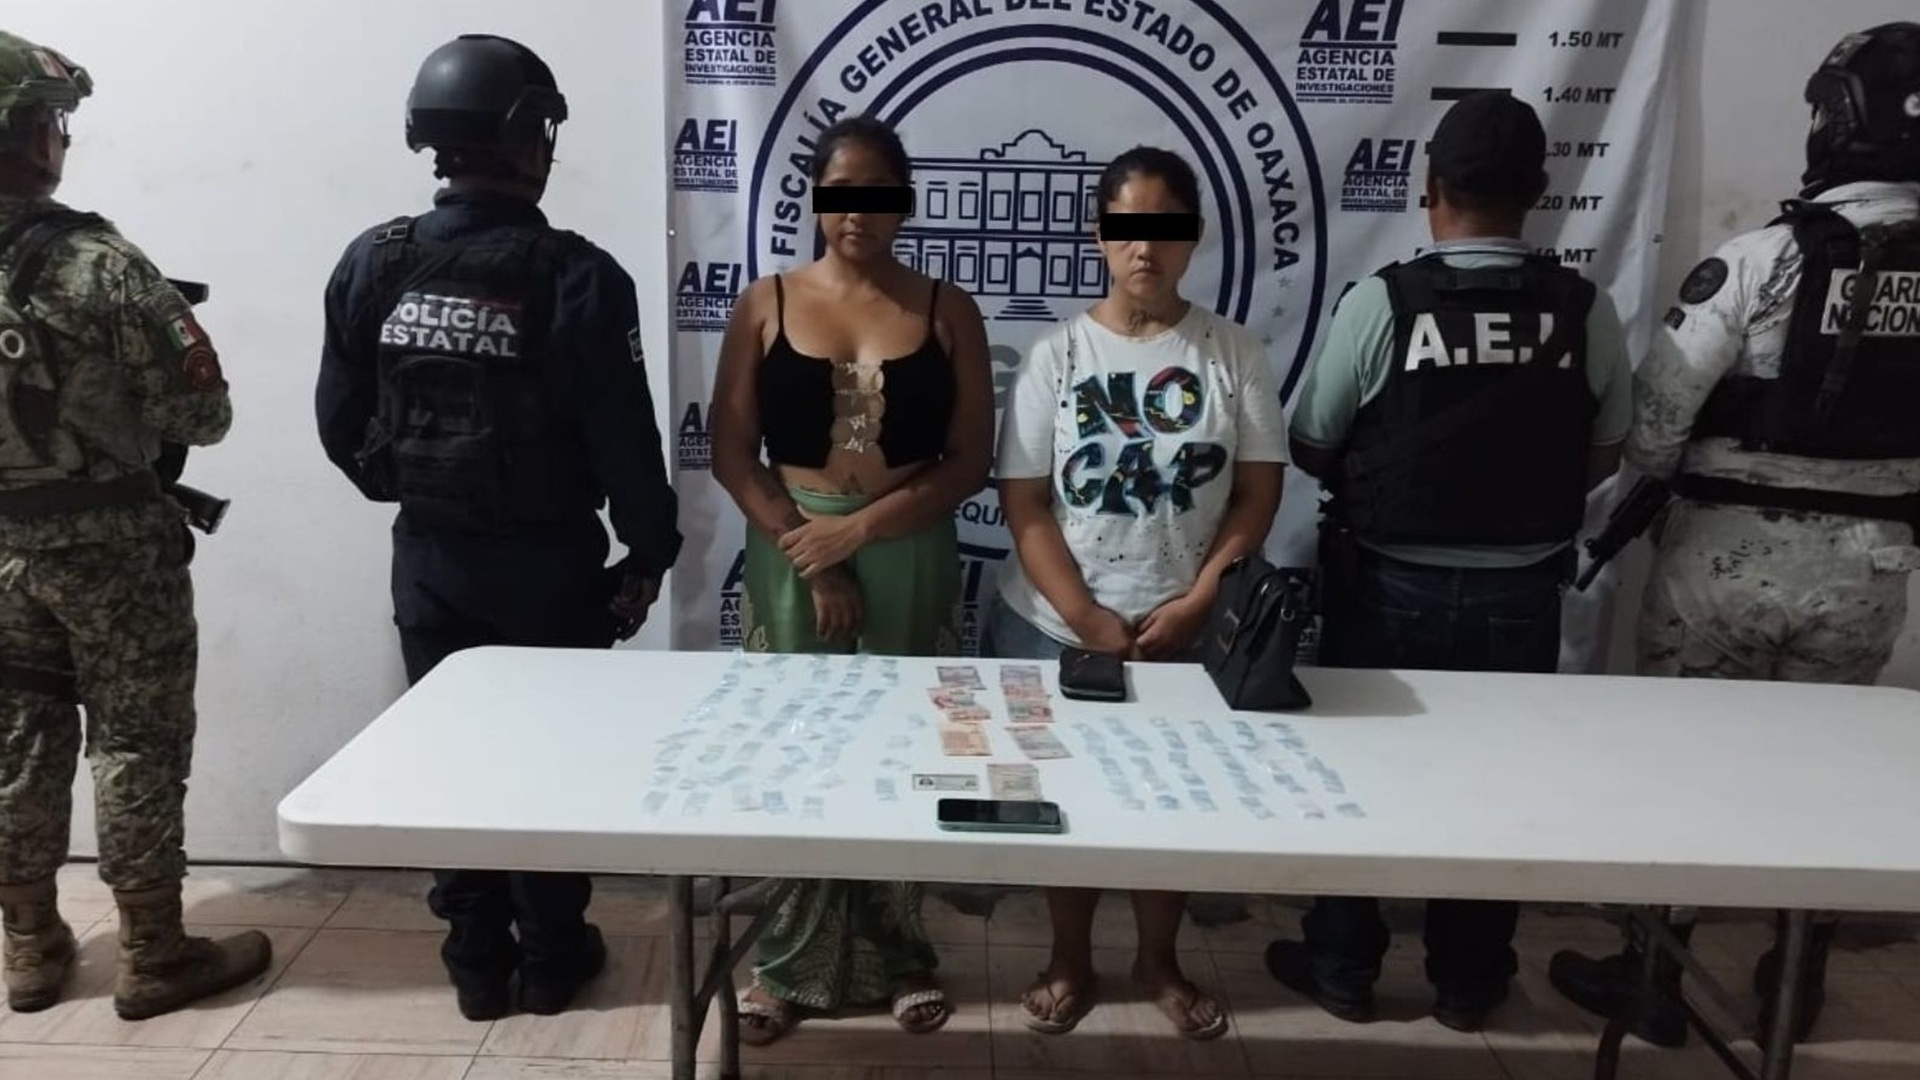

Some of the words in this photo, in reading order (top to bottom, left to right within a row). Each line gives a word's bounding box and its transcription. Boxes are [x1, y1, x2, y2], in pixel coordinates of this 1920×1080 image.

[1301, 0, 1405, 41] AEI
[685, 30, 775, 48] AGENCIA
[1548, 31, 1593, 48] 1.50
[1596, 32, 1624, 49] MT
[685, 48, 749, 62] ESTATAL
[755, 50, 776, 64] DE
[1297, 49, 1395, 66] AGENCIA
[685, 63, 776, 74] INVESTIGACIONES
[1297, 66, 1368, 81] ESTATAL
[1373, 68, 1396, 82] DE
[1295, 82, 1394, 93] INVESTIGACIONES
[1543, 86, 1581, 103] 1.40
[1585, 87, 1616, 104] MT
[674, 118, 737, 150] AEI
[840, 0, 993, 93] GENERAL
[1084, 0, 1216, 72] ESTADO
[1212, 68, 1258, 121] DE
[1247, 122, 1300, 271] OAXACA
[1345, 138, 1417, 170] AEI
[1545, 142, 1571, 158] .30
[1577, 142, 1610, 158] MT
[674, 155, 737, 167] AGENCIA
[674, 167, 721, 178] ESTATAL
[724, 168, 739, 178] DE
[1343, 174, 1408, 187] AGENCIA
[1569, 195, 1603, 211] MT
[1564, 248, 1597, 263] MT
[677, 261, 742, 293] AEI
[380, 323, 517, 357] ESTATAL
[1073, 366, 1205, 440] NO
[1061, 441, 1228, 517] CAP
